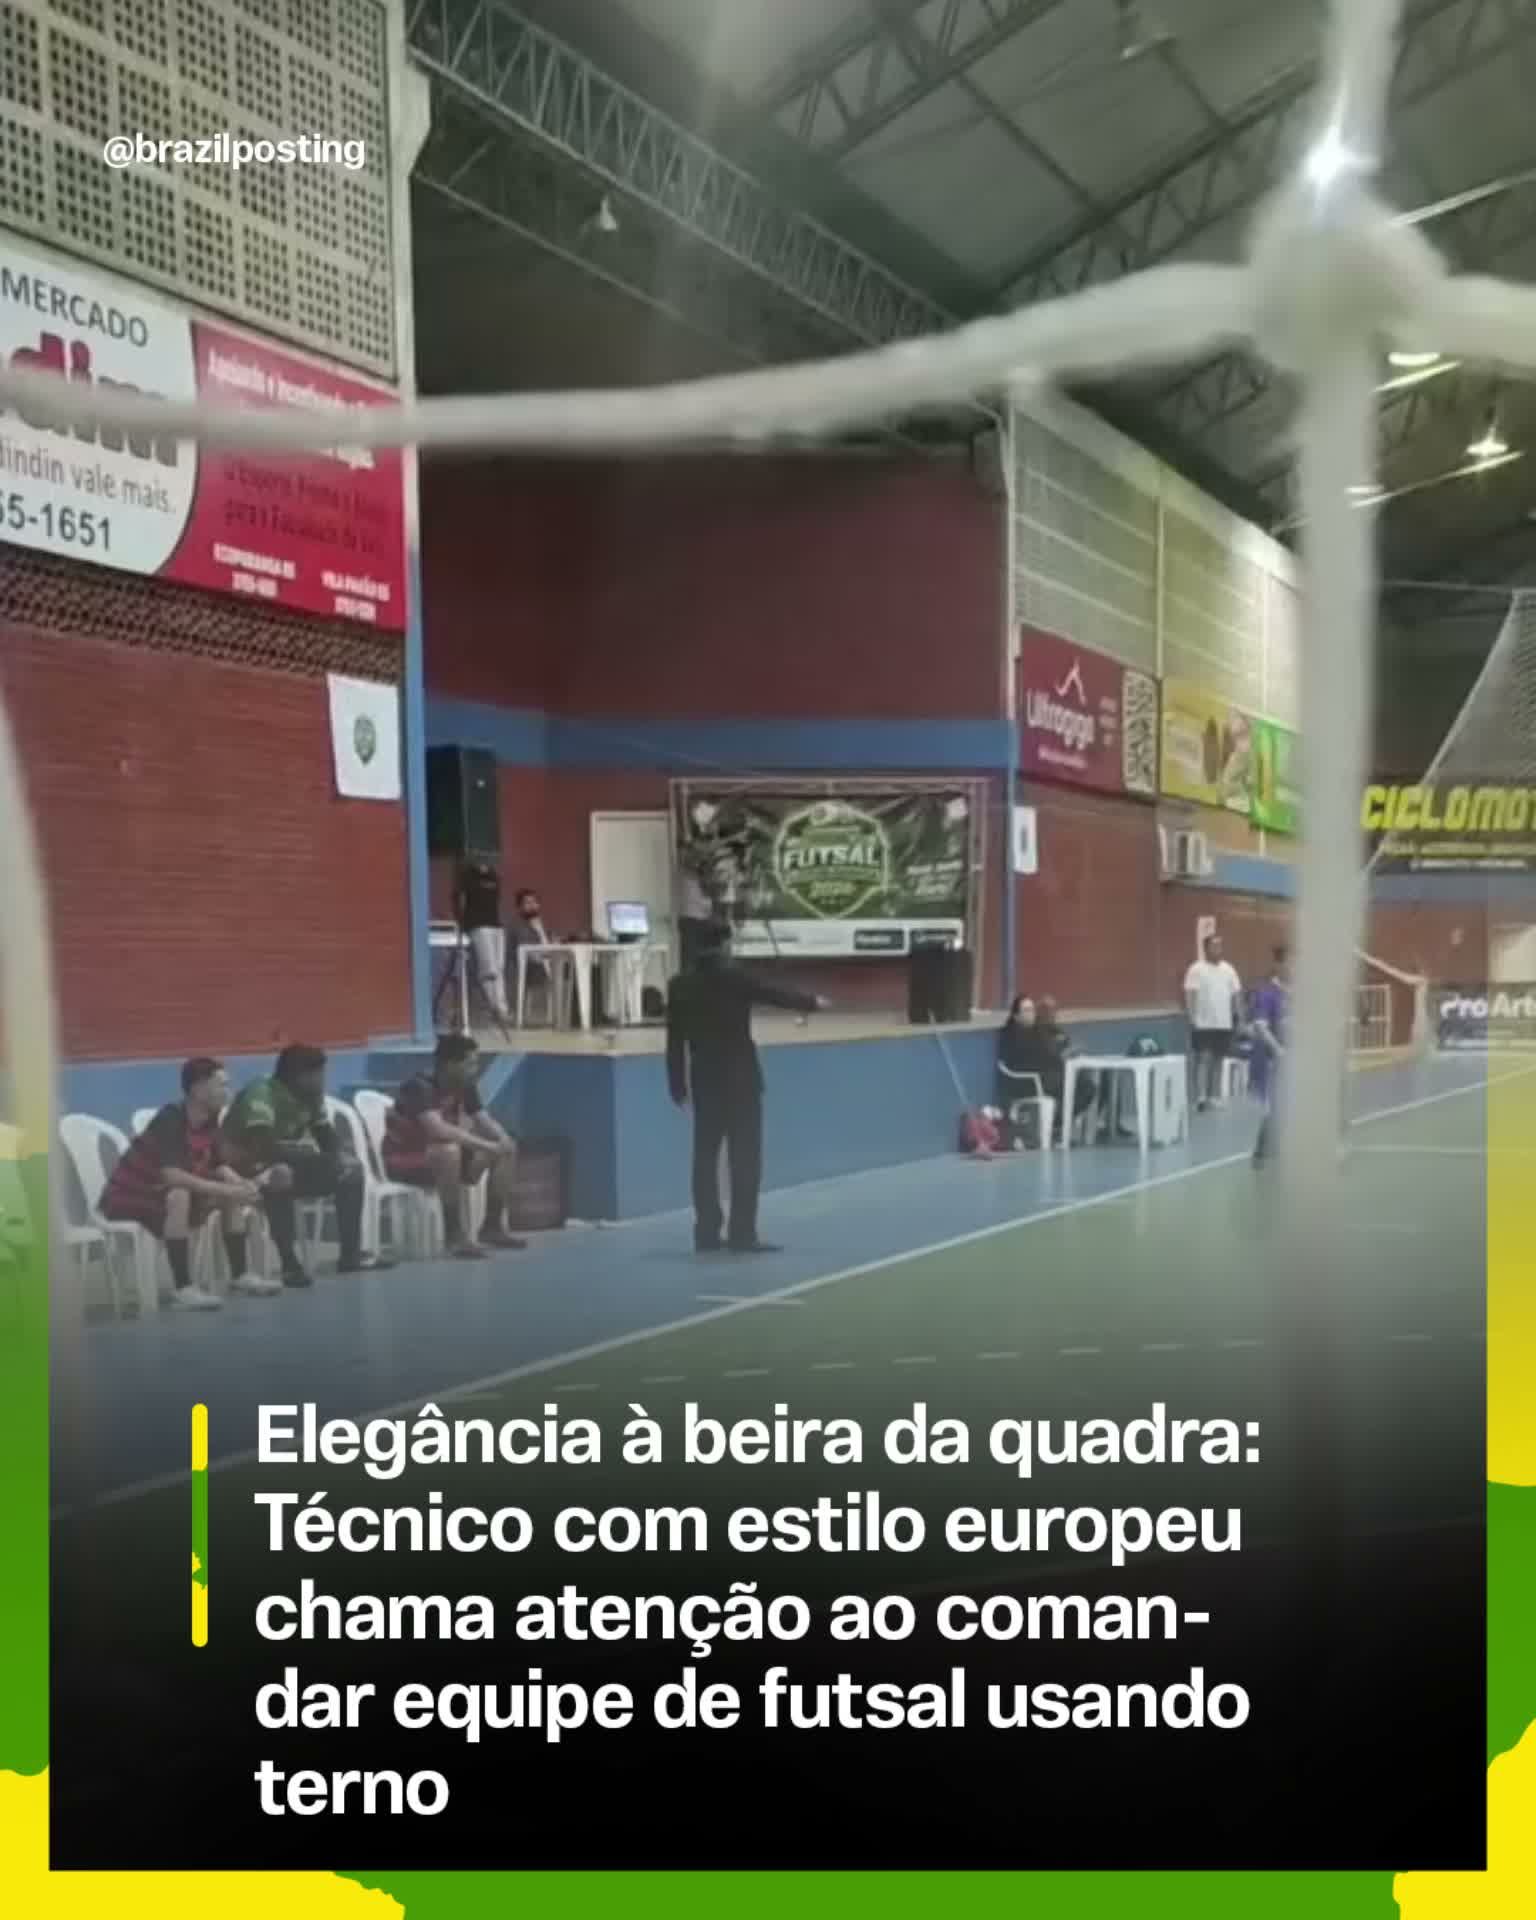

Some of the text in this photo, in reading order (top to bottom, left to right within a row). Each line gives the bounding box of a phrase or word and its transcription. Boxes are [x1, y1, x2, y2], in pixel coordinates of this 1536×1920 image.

[1, 266, 149, 348] MERCADO
[70, 462, 116, 499] vale
[783, 845, 880, 870] FUTSAL
